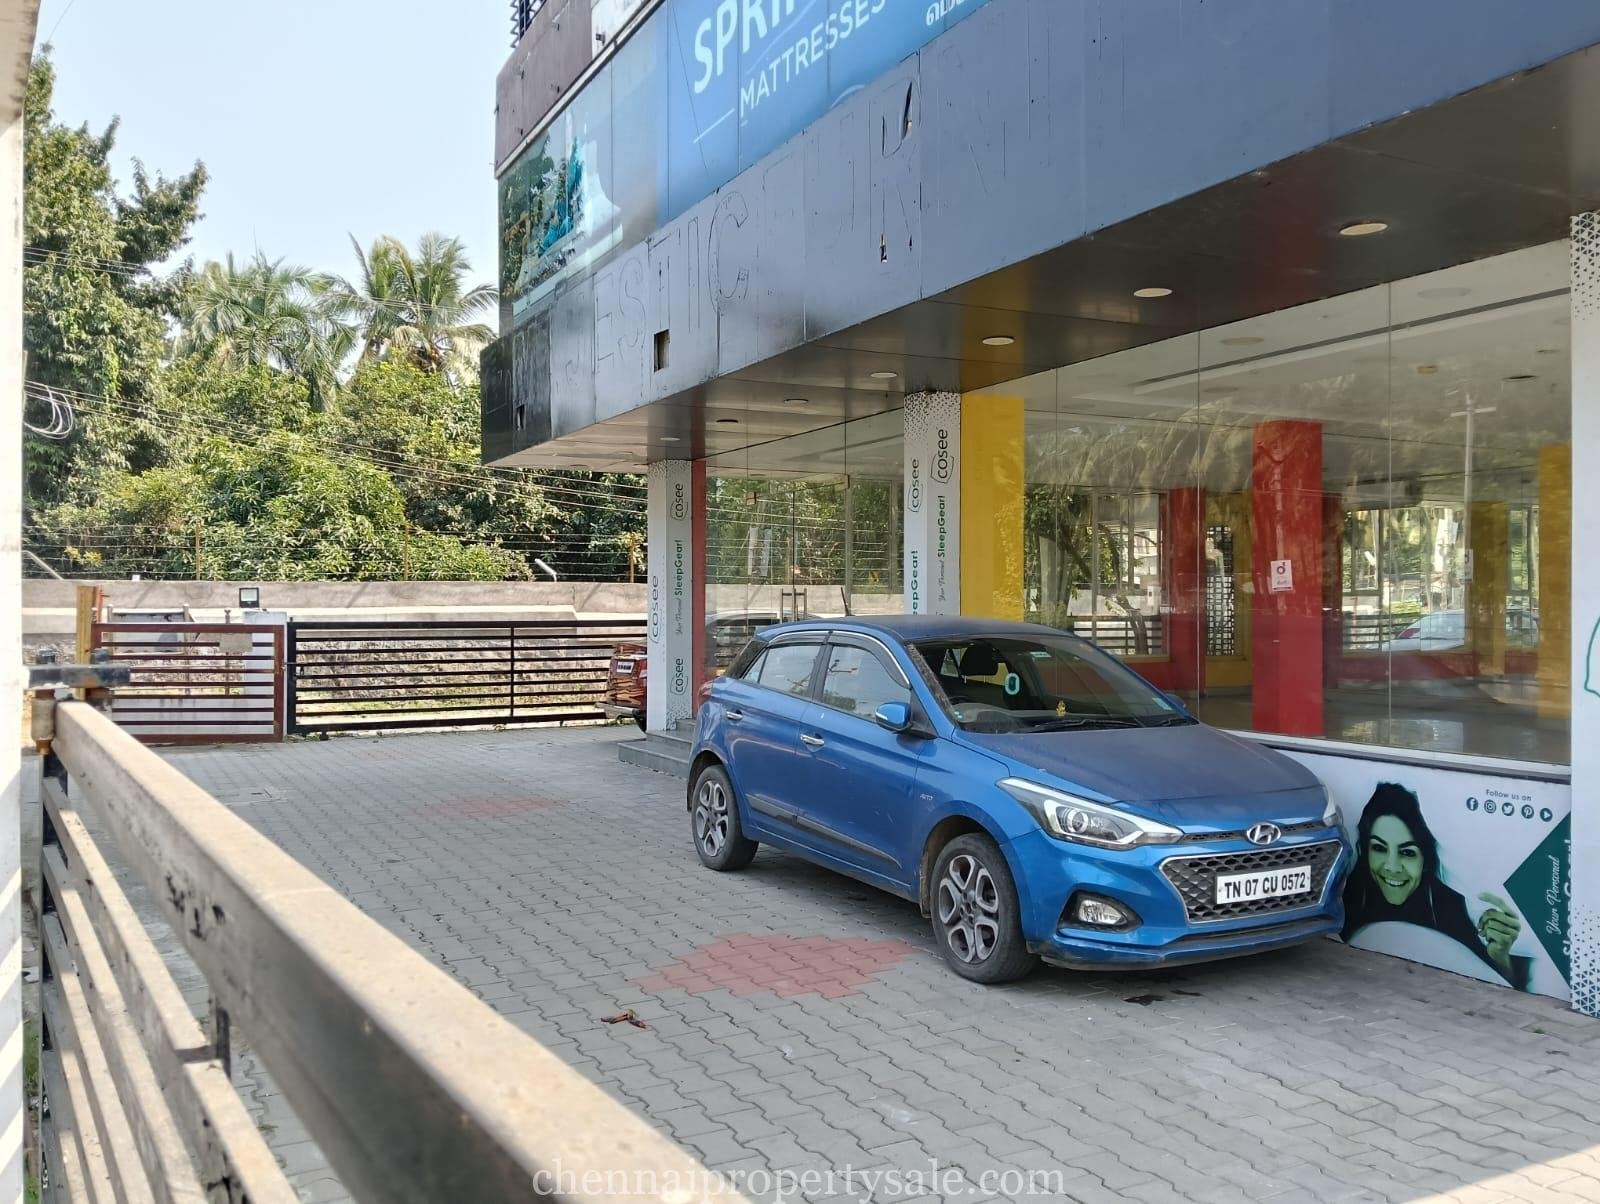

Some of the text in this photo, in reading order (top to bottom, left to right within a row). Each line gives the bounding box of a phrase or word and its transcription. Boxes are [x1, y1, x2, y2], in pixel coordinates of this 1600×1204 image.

[1486, 789, 1509, 798] Follow
[1224, 872, 1306, 899] TN 07 CU 0572
[1546, 855, 1562, 935] Your Personal
